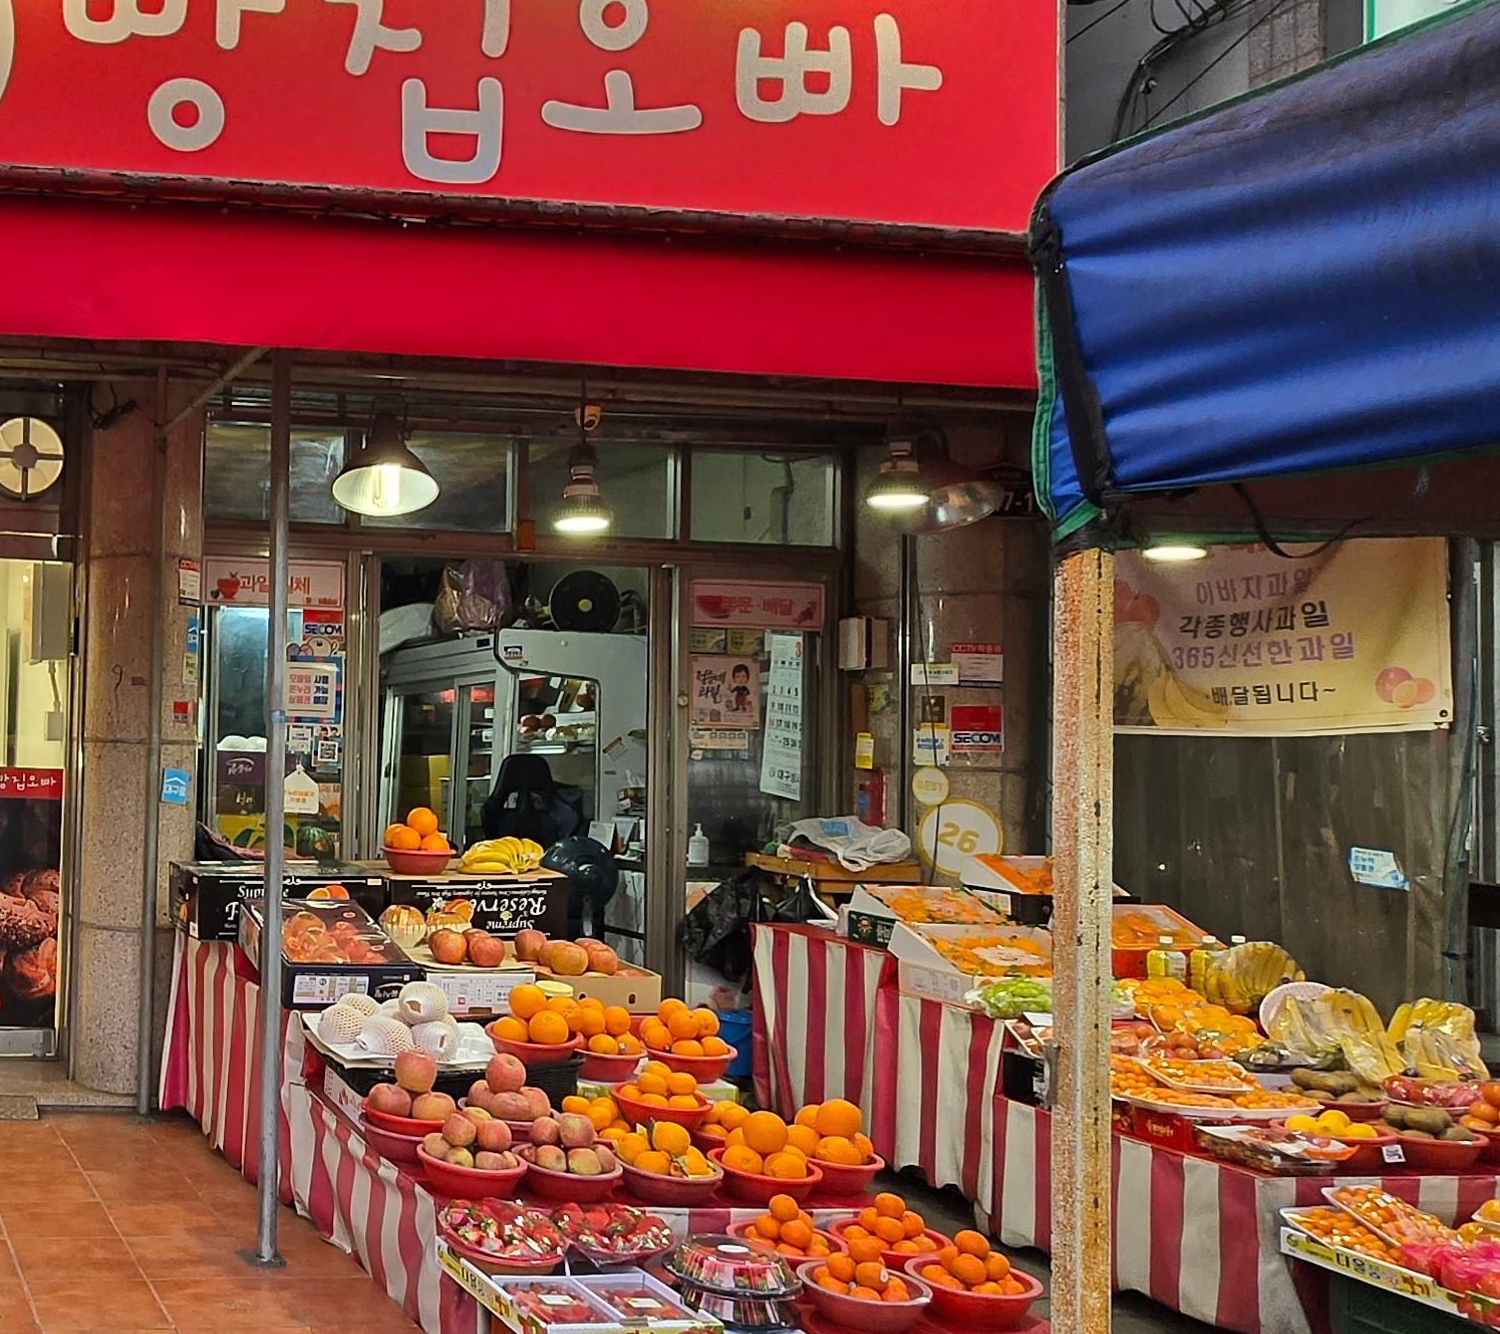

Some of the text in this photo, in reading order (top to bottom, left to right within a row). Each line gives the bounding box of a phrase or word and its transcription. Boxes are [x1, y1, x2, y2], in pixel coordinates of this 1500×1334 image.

[305, 624, 342, 635] SECOM
[954, 733, 1000, 743] SECOM
[917, 780, 943, 792] BEST
[938, 822, 980, 854] 26
[486, 915, 535, 929] Suprme
